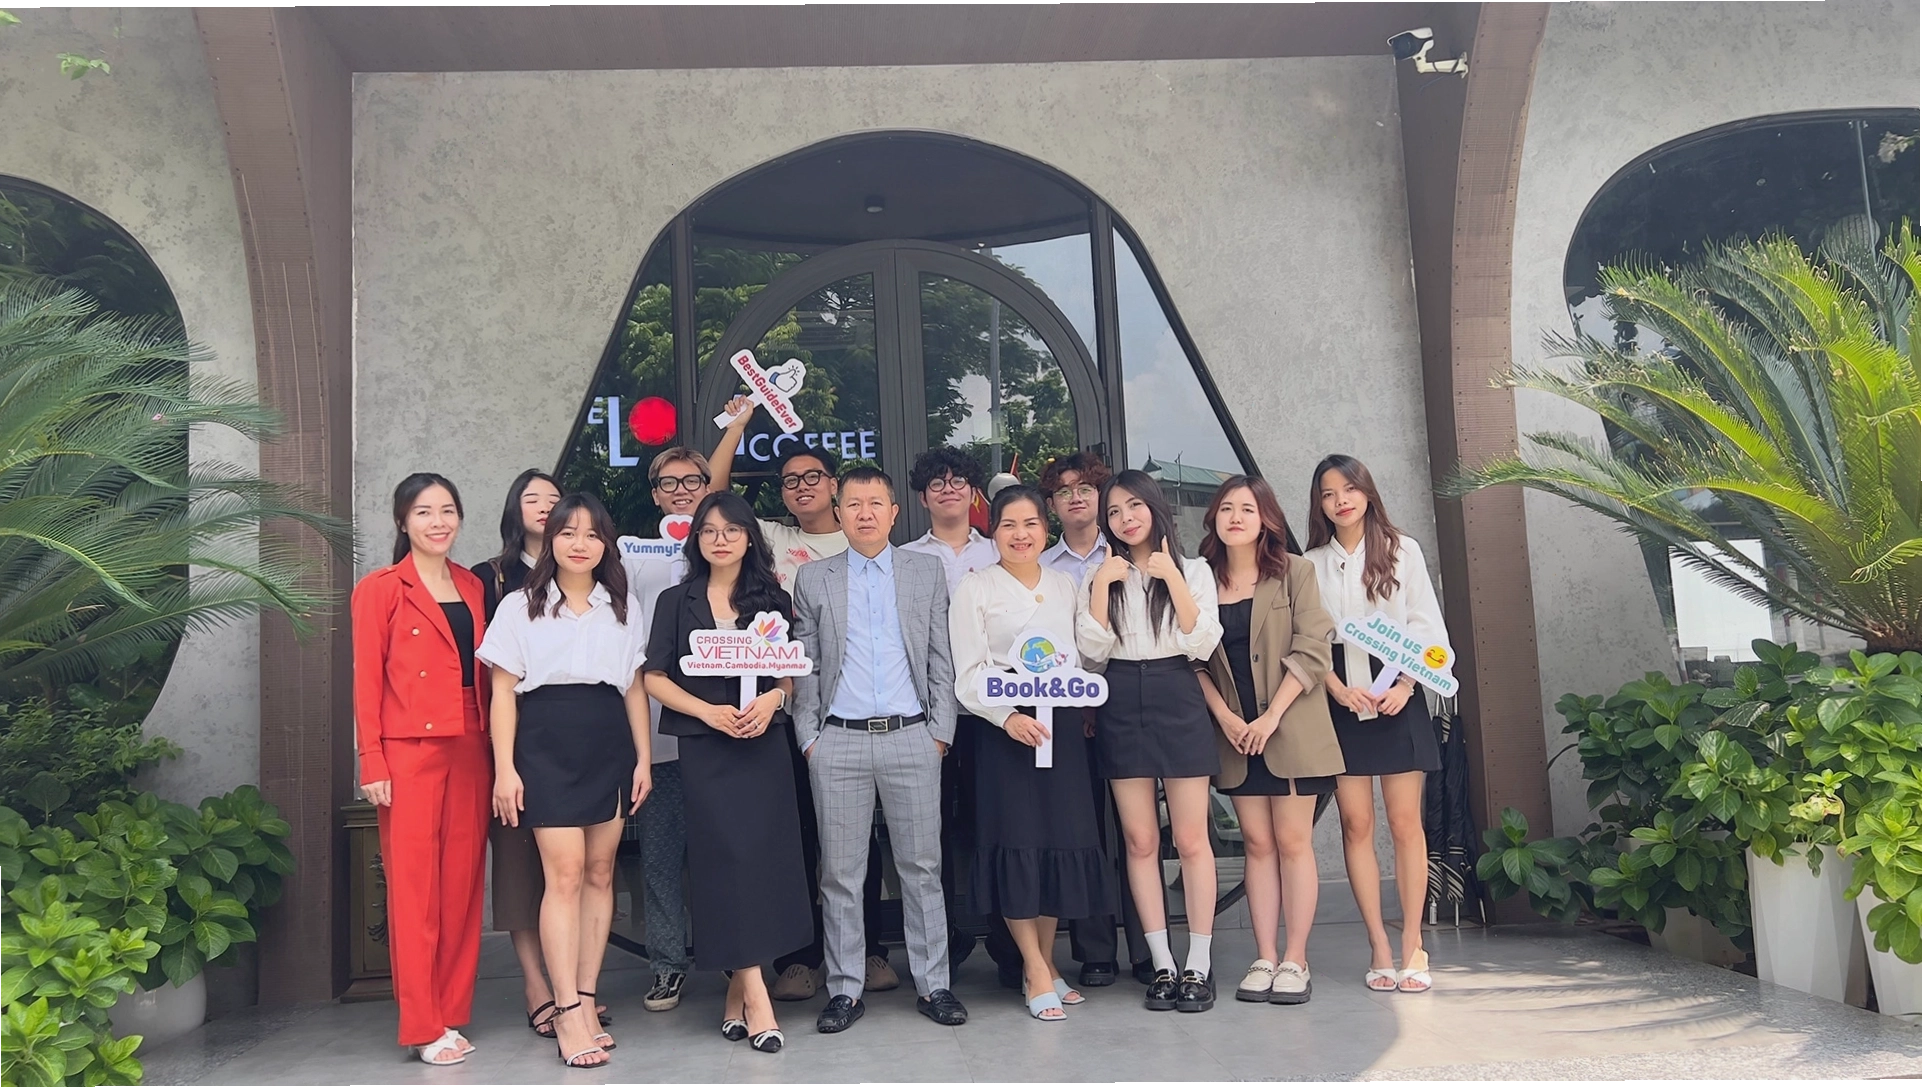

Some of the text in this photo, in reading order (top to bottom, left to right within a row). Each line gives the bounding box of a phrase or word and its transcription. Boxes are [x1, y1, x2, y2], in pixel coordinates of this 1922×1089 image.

[737, 355, 797, 428] BestGuideEver
[624, 542, 685, 557] YummyF
[696, 636, 753, 645] CROSSING
[1366, 618, 1423, 655] Join us
[697, 646, 798, 660] VIETNAM
[1344, 622, 1452, 691] Crossing Vietnam
[986, 677, 1100, 698] Book&Go
